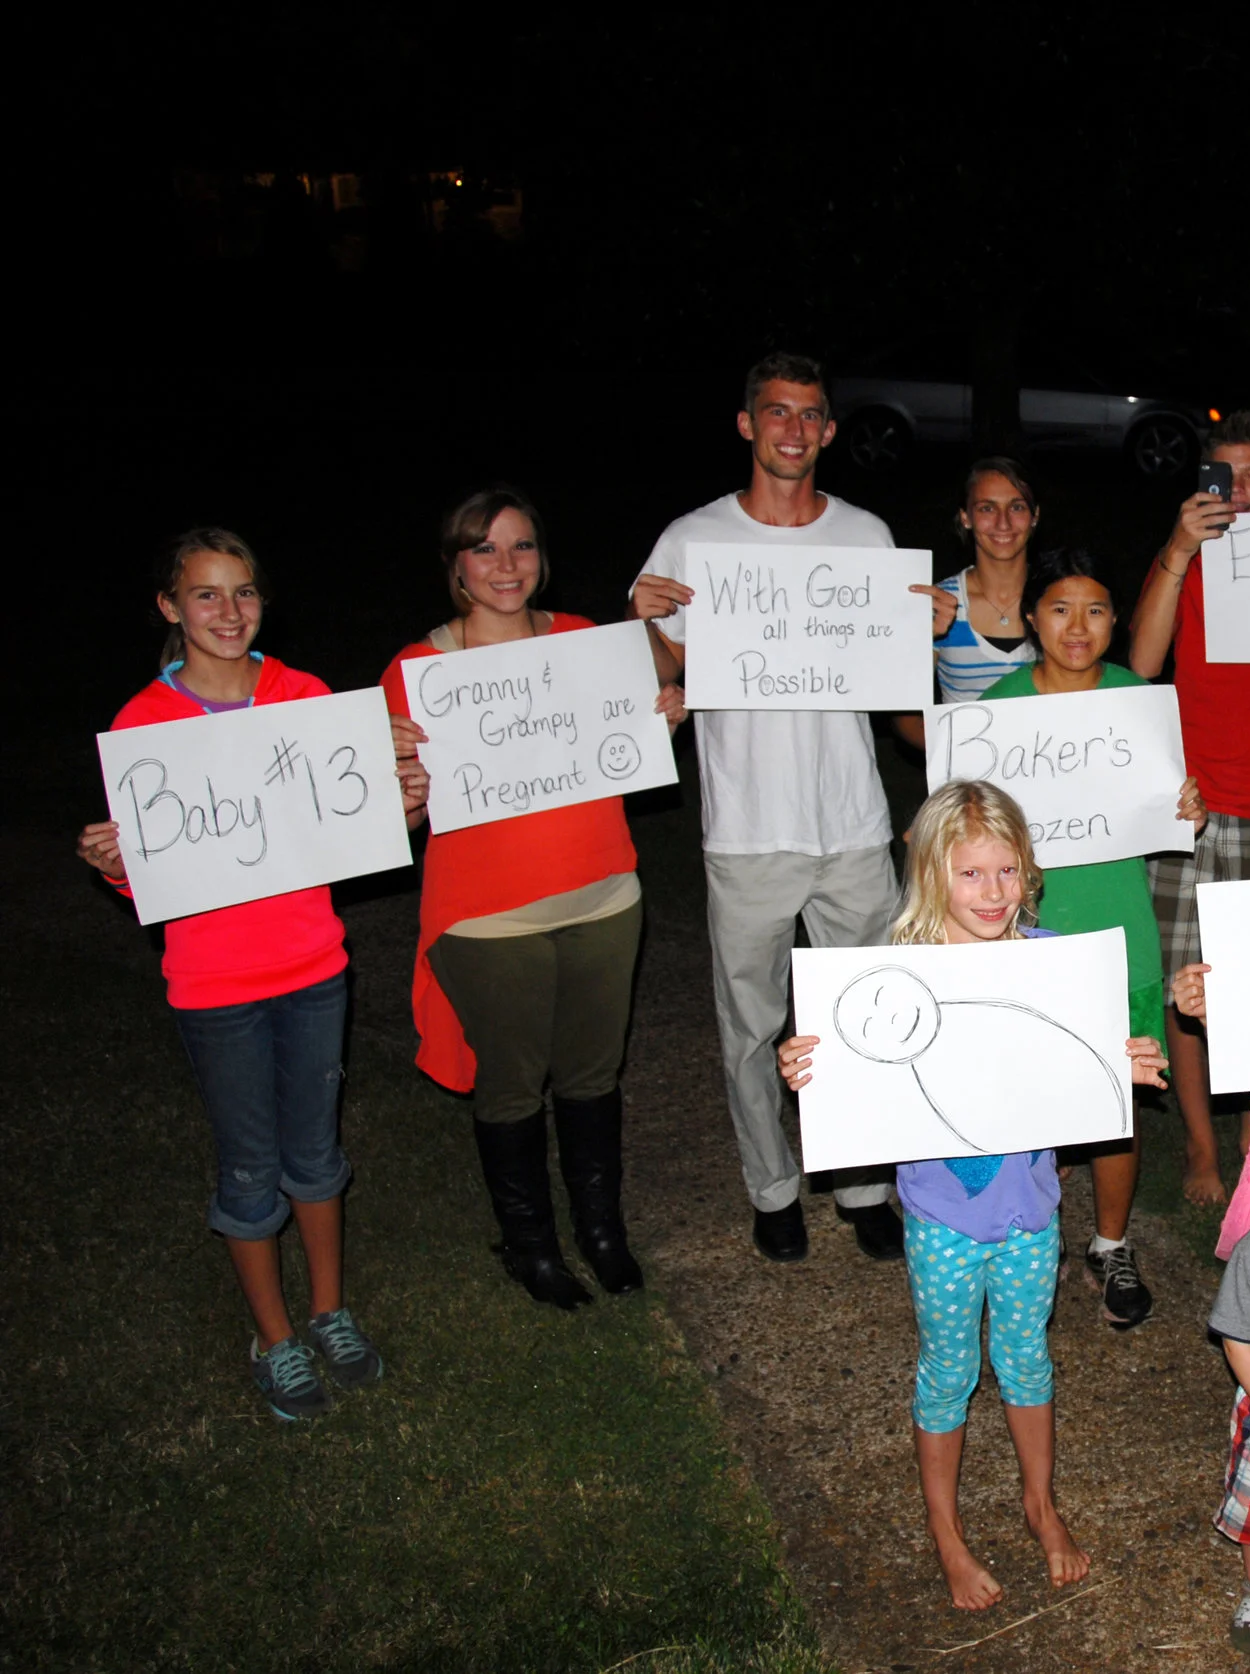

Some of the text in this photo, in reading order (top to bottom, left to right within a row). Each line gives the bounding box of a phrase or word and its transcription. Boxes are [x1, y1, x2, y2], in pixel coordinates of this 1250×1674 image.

[705, 561, 871, 615] With God
[762, 616, 894, 648] all things are
[419, 661, 533, 718] Granny
[732, 651, 852, 697] Possible
[479, 697, 636, 747] Grampy are
[938, 703, 1133, 783] Baker's
[117, 736, 369, 867] Baby #13
[454, 760, 587, 813] Pregnant
[1028, 812, 1112, 844] ozen
